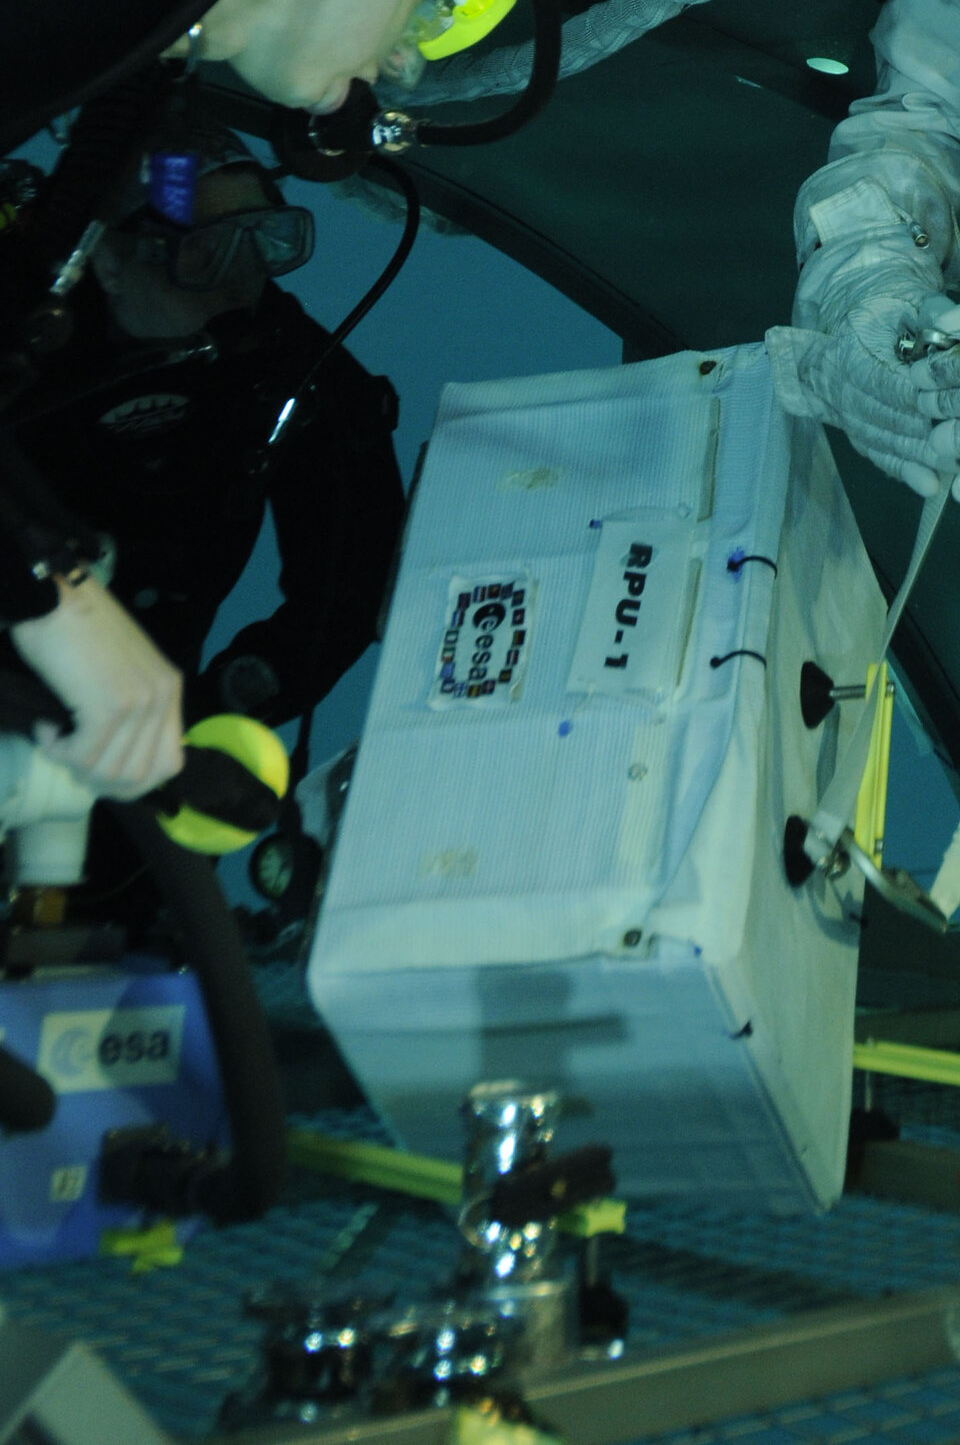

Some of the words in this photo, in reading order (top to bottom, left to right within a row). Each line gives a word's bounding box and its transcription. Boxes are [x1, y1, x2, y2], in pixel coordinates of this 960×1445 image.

[604, 542, 653, 670] RPU-1
[468, 633, 495, 681] esa
[98, 1029, 171, 1065] esa
